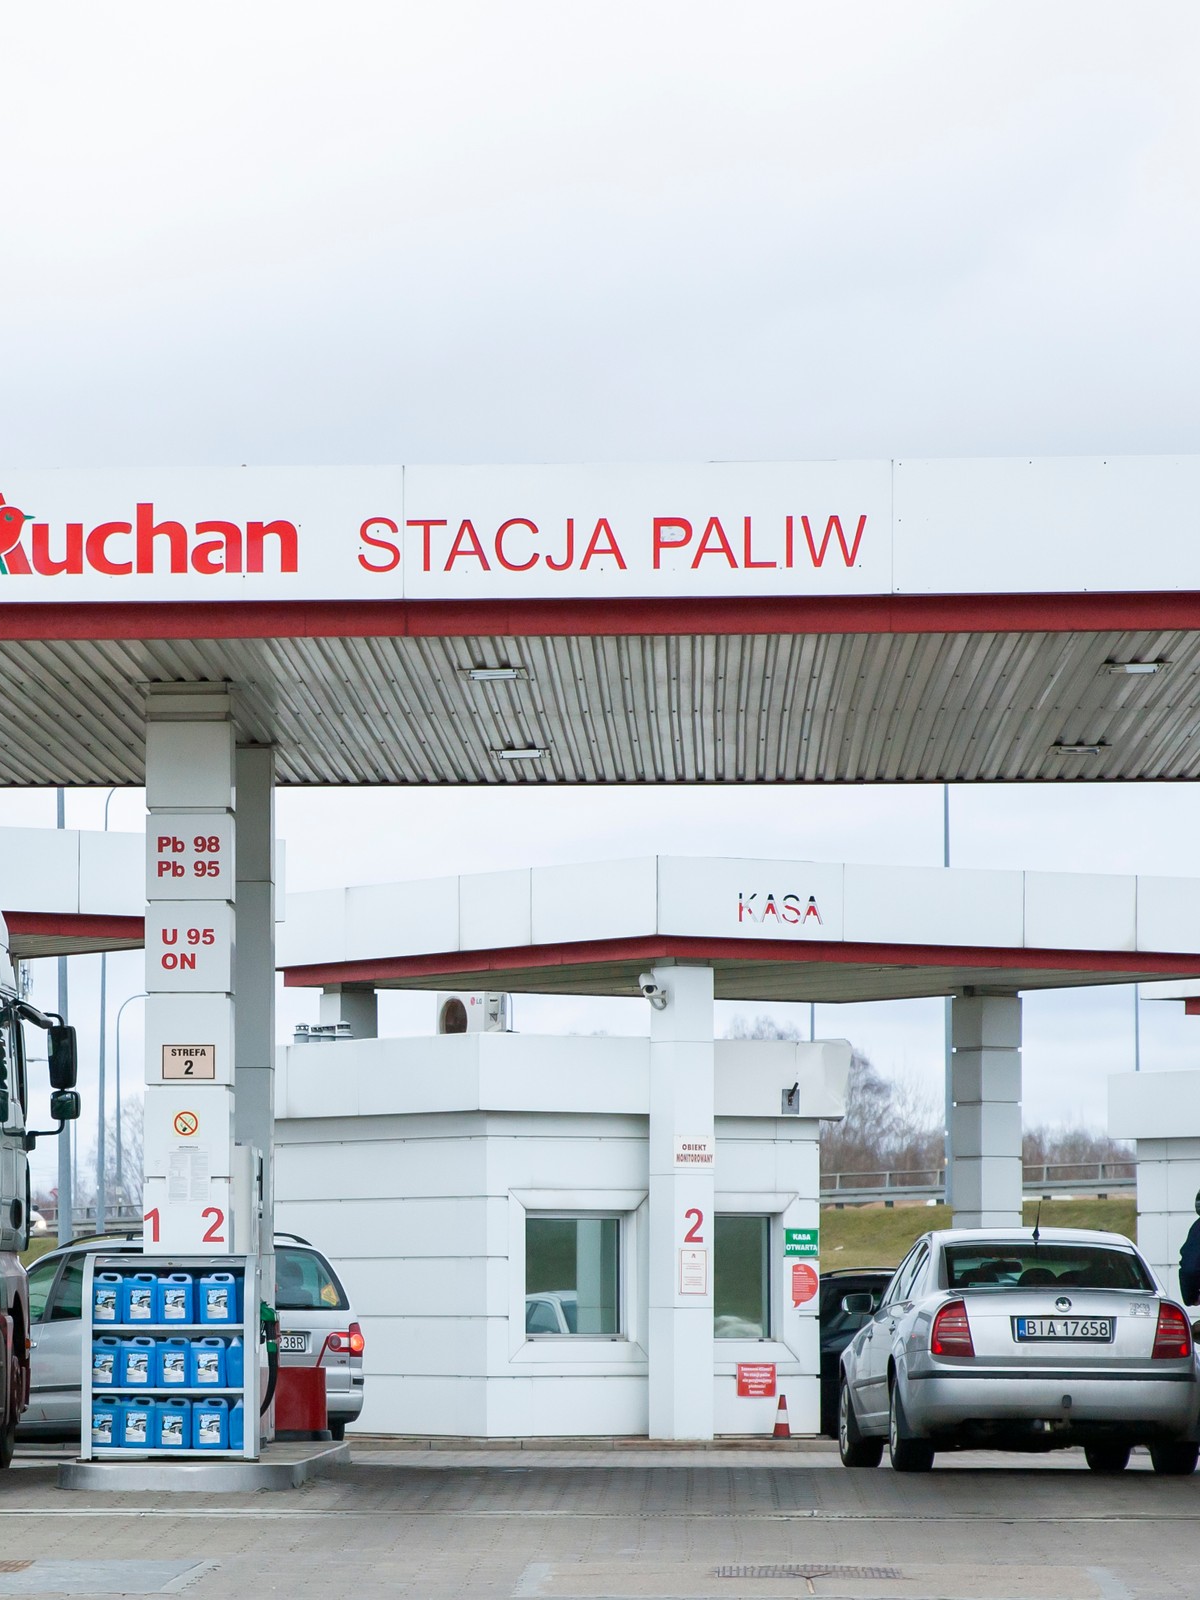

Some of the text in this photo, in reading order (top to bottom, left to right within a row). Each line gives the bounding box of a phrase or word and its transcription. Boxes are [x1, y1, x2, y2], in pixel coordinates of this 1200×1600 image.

[357, 514, 867, 573] STACJA PALIW
[157, 836, 221, 853] Pb 98
[157, 861, 221, 878] Pb 95
[738, 892, 824, 925] KASA
[161, 928, 215, 946] U 95
[161, 952, 197, 970] ON
[171, 1048, 207, 1057] STREFA
[184, 1060, 194, 1075] 2
[676, 1153, 713, 1164] MONITOROWANY
[143, 1207, 225, 1243] 1 2
[684, 1208, 703, 1243] 2
[792, 1233, 812, 1241] KASA
[785, 1243, 818, 1252] OTWARTA
[1026, 1320, 1108, 1336] BIA 17658
